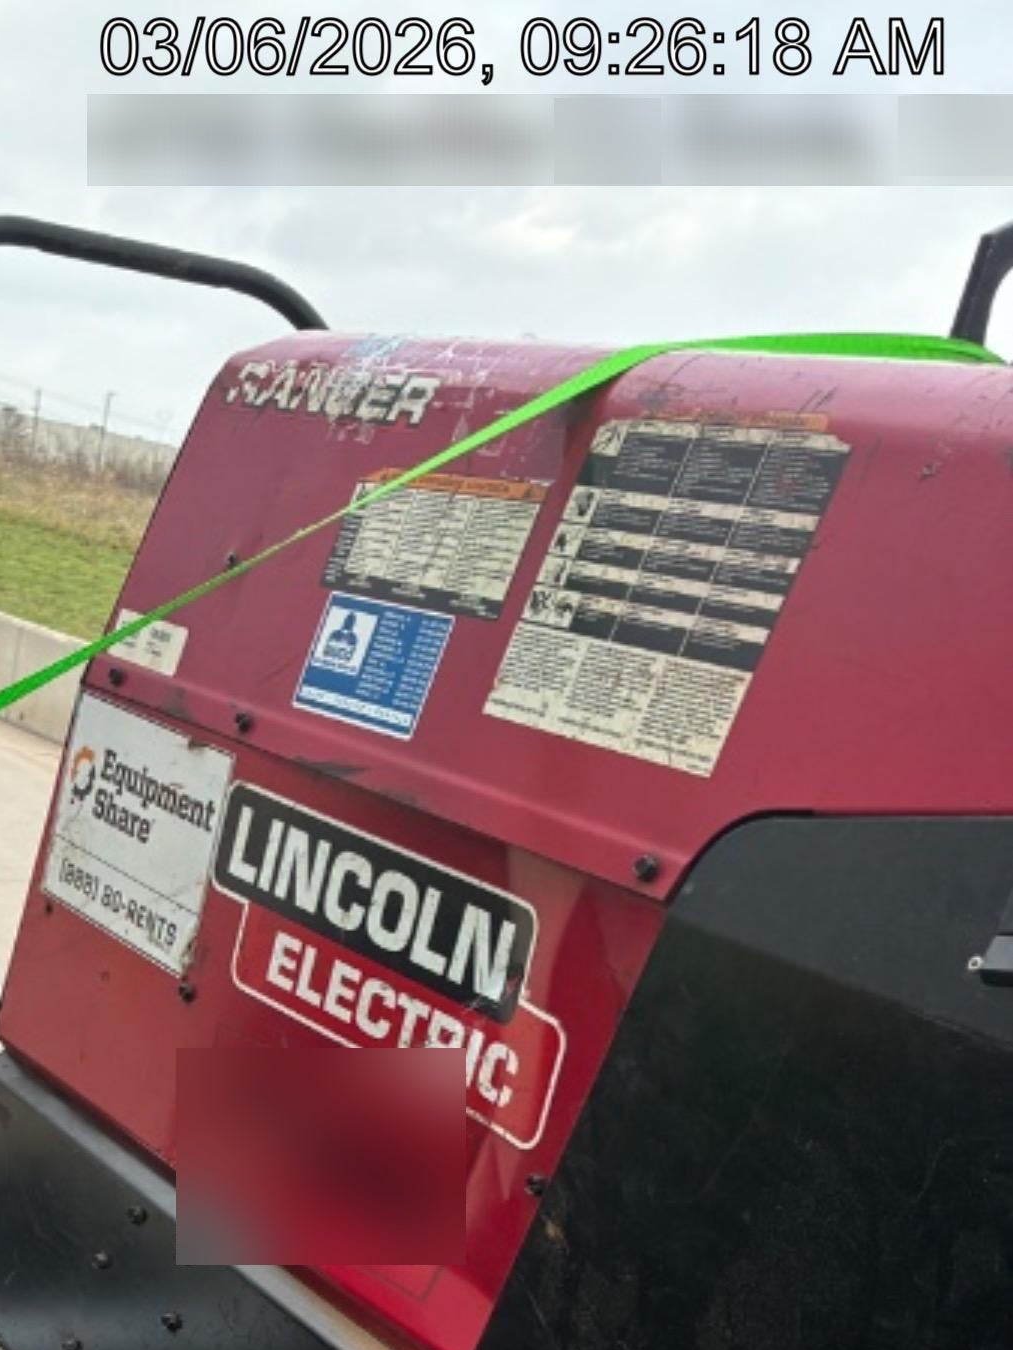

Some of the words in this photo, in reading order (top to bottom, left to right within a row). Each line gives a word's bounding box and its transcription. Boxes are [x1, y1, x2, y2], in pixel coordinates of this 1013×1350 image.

[92, 788, 151, 844] Share
[100, 749, 217, 832] Equipment
[101, 884, 178, 946] 80-RENTS
[227, 805, 518, 1002] LINCOLN
